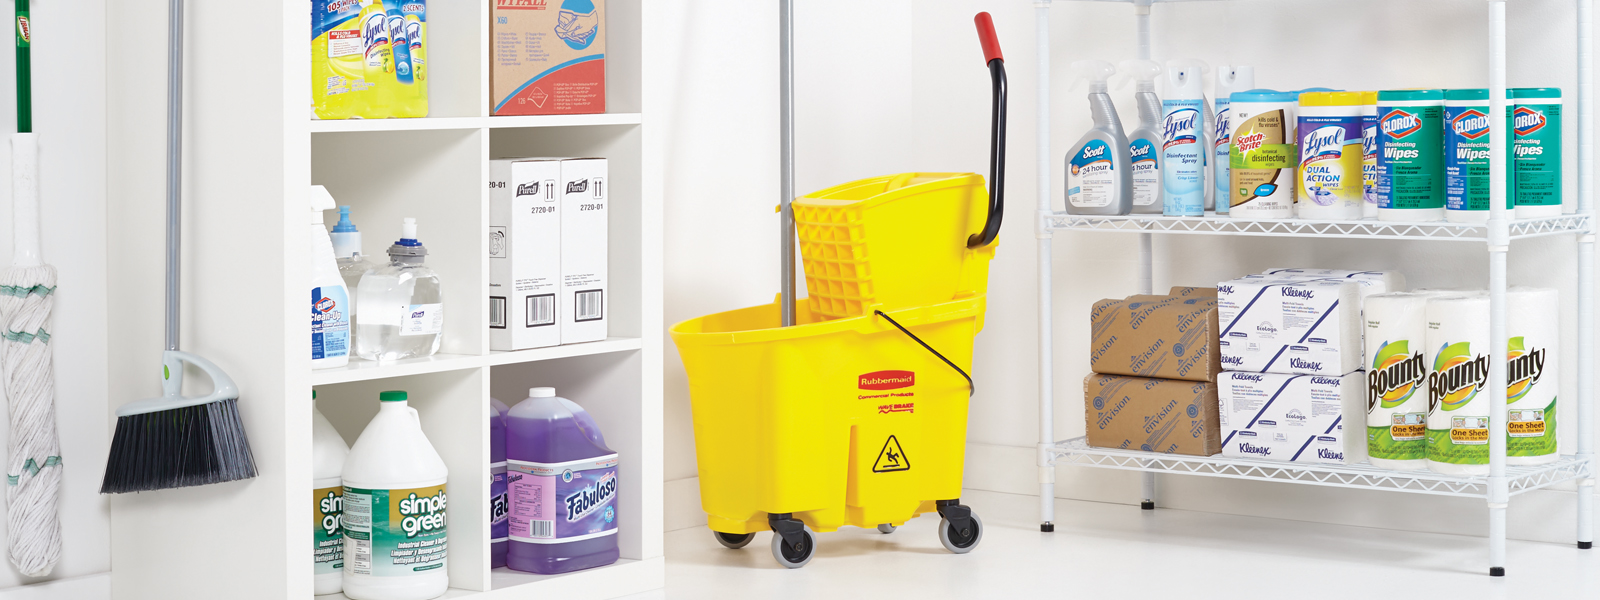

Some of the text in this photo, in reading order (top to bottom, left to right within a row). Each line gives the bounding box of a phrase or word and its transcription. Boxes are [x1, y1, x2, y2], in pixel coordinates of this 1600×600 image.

[328, 1, 341, 12] 105
[497, 16, 508, 24] X60
[363, 17, 386, 48] Lysol
[390, 20, 404, 44] ysol
[407, 26, 420, 48] ysol
[1163, 112, 1196, 140] Lysol
[1382, 113, 1418, 134] CLOROX
[1455, 113, 1490, 134] CLOROX
[1240, 141, 1261, 152] Brite
[1305, 128, 1342, 155] Lysol
[1083, 145, 1105, 159] Scott
[1130, 145, 1150, 158] Scott
[1252, 154, 1286, 163] disinfecting
[1384, 148, 1419, 160] Wipes
[1457, 148, 1490, 161] Wipes
[1083, 167, 1090, 175] 24
[518, 182, 538, 196] Purell
[567, 181, 587, 194] Purell
[1282, 287, 1314, 300] Kleenex
[1132, 339, 1164, 373] envision
[1290, 357, 1322, 372] Kleenex
[861, 376, 912, 385] Rubbermaid
[1232, 373, 1263, 383] Kleenex
[1368, 350, 1425, 414] Bounty
[1428, 353, 1490, 417] Bounty
[1099, 396, 1130, 430] envision
[1145, 400, 1178, 434] envision
[1239, 442, 1271, 456] Kleenex
[400, 490, 446, 515] simple
[566, 477, 616, 520] Fabuloso
[402, 511, 446, 536] green
[393, 557, 416, 565] Nettoyant
